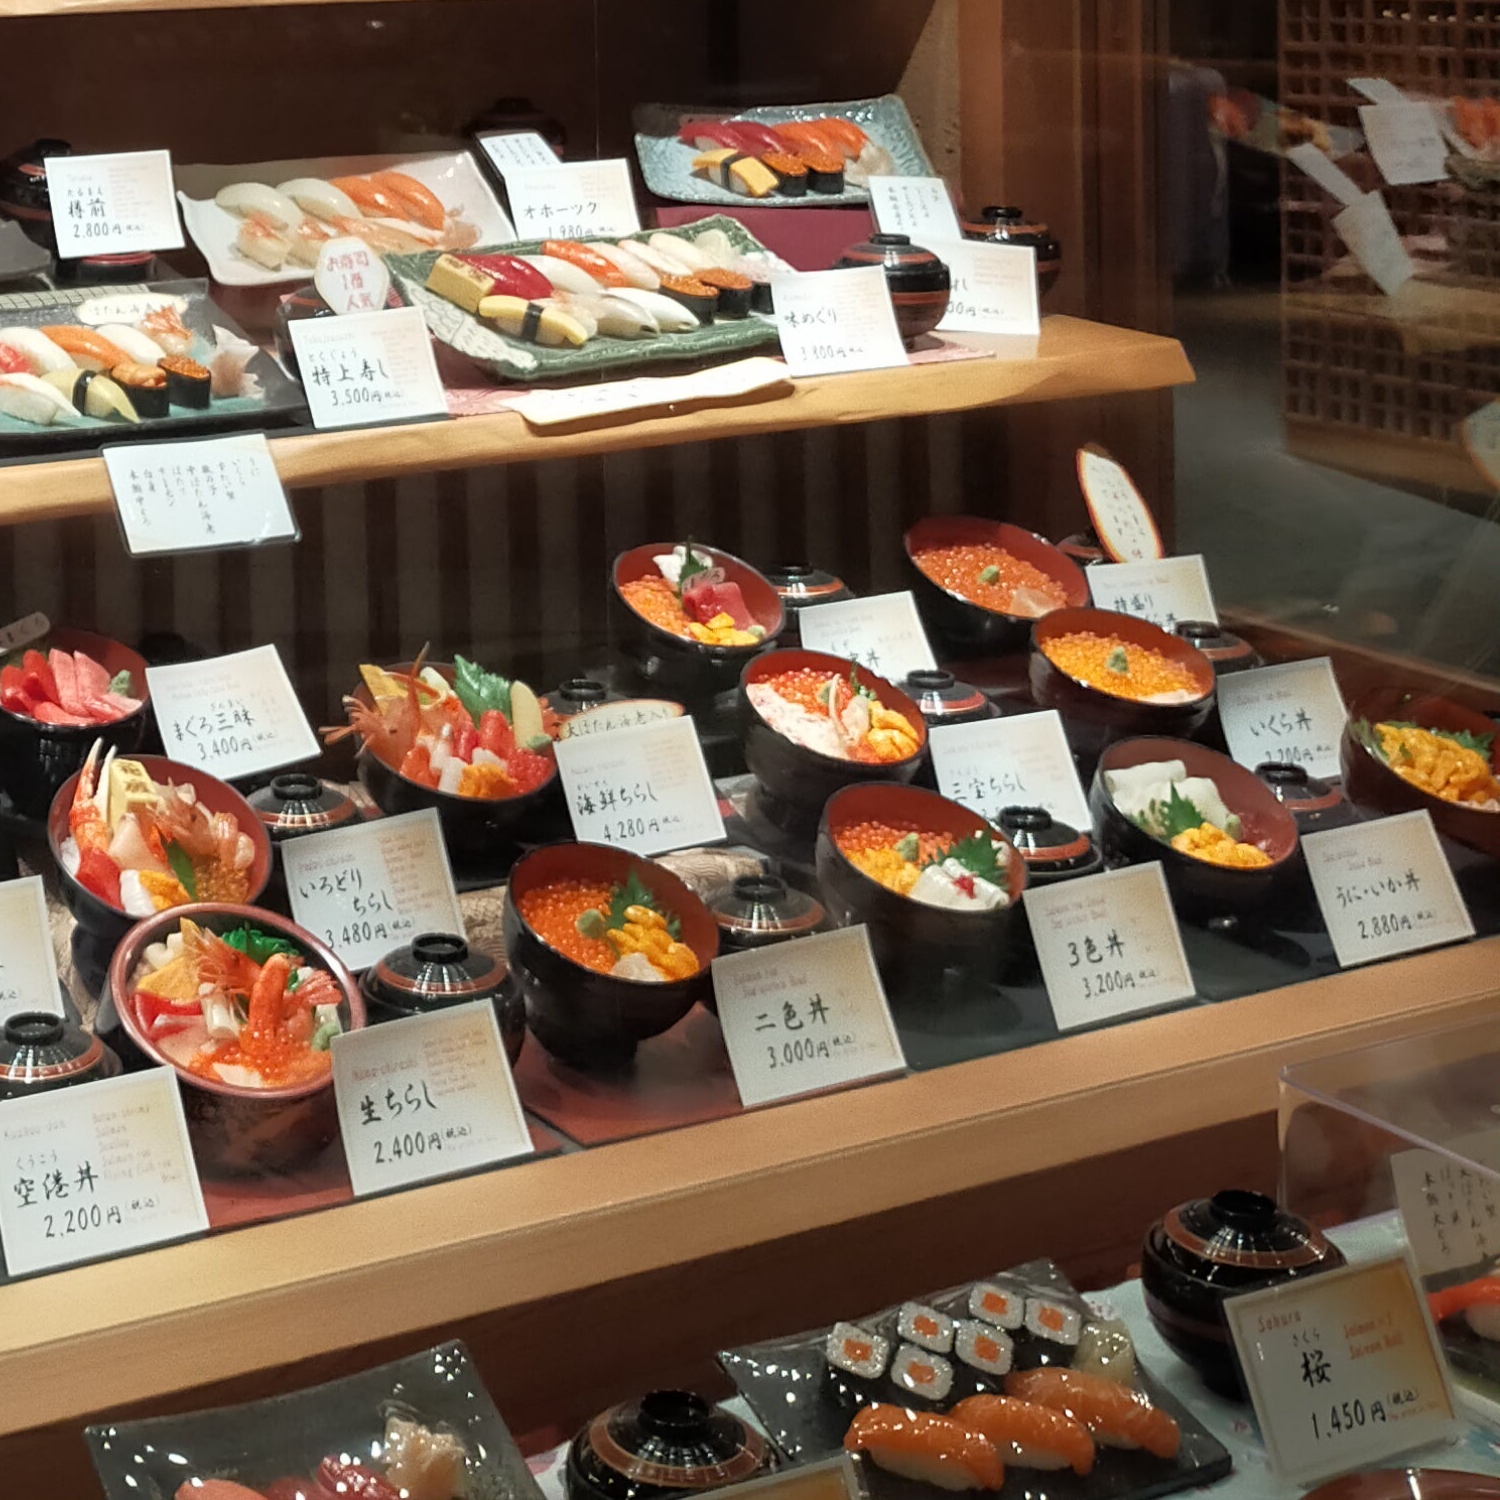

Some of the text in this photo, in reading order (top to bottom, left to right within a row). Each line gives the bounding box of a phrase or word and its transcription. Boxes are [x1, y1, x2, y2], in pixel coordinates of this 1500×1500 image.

[523, 201, 598, 220] オホーツク
[784, 306, 838, 329] 味めぐり
[311, 358, 389, 388] 特上寿し
[1249, 707, 1313, 737] いくら丼
[576, 781, 658, 816] 海鮮ちらし
[299, 867, 363, 900] いろどり
[353, 889, 394, 918] ちらし
[1067, 928, 1125, 969] 3色丼
[754, 992, 830, 1033] 二色丼
[359, 1078, 439, 1126] 生ちらし
[13, 1160, 99, 1209] 空港丼
[1257, 1310, 1302, 1334] Sakura
[1299, 1348, 1333, 1389] 桜
